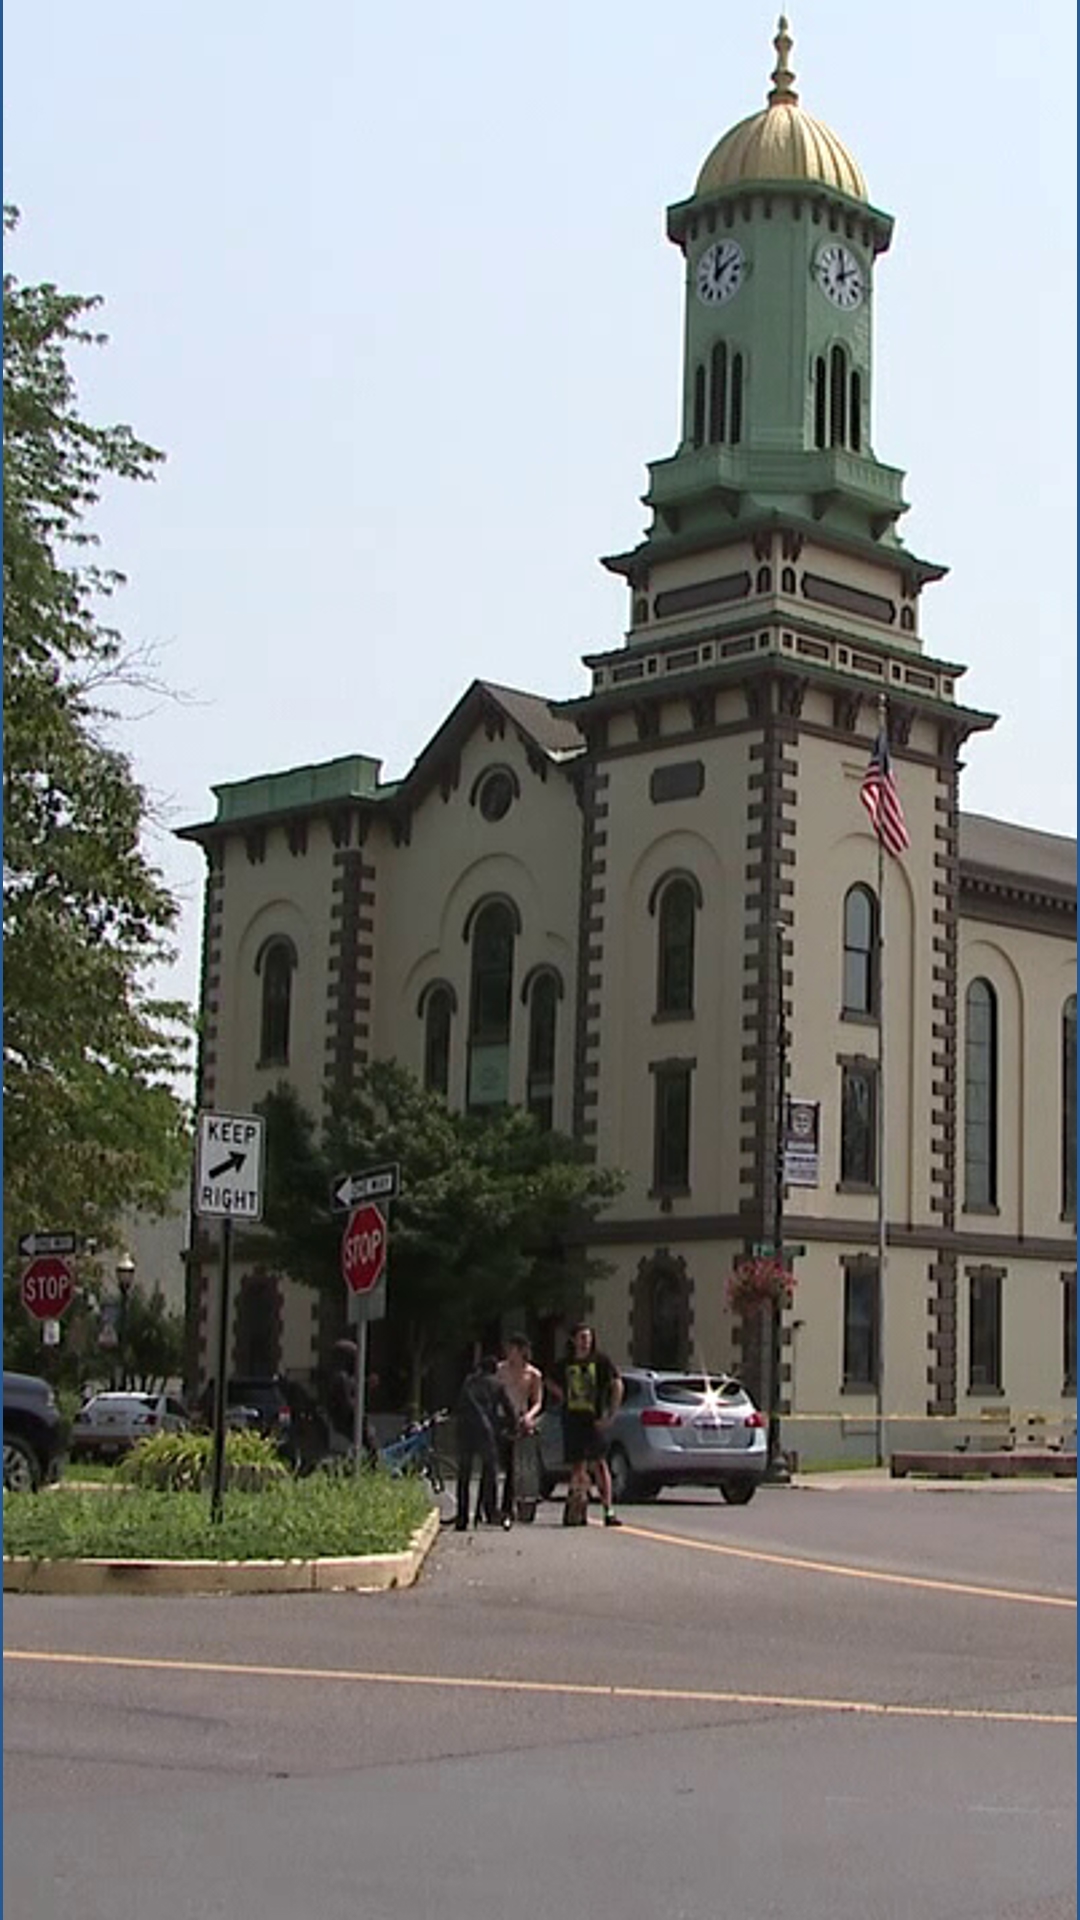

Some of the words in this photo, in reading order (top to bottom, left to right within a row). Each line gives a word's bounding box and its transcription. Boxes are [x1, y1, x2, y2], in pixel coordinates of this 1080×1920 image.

[208, 1121, 257, 1145] KEEP
[203, 1185, 257, 1211] RIGHT
[345, 1229, 381, 1269] STOP
[26, 1275, 68, 1302] STOP
